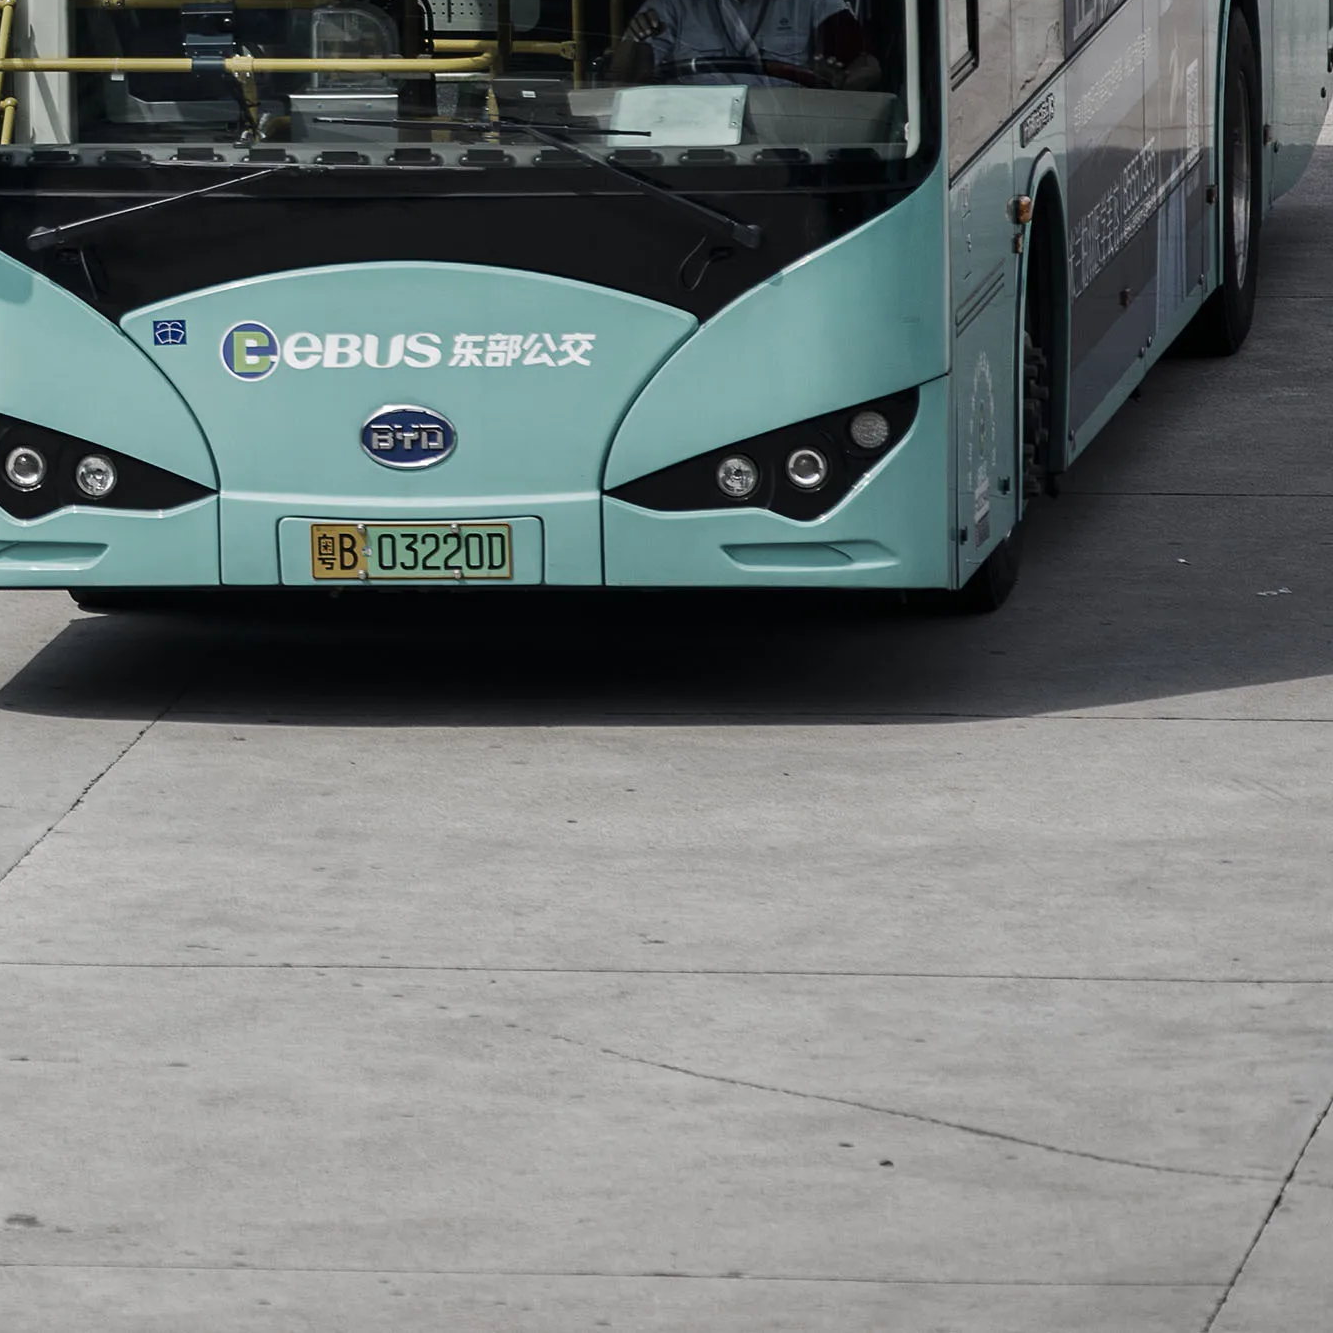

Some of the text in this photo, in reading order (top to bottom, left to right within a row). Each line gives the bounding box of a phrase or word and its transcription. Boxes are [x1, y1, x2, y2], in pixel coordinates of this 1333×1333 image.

[448, 332, 597, 368] 东部公交
[370, 423, 445, 451] BYD
[317, 531, 506, 572] 粤B 03220D
